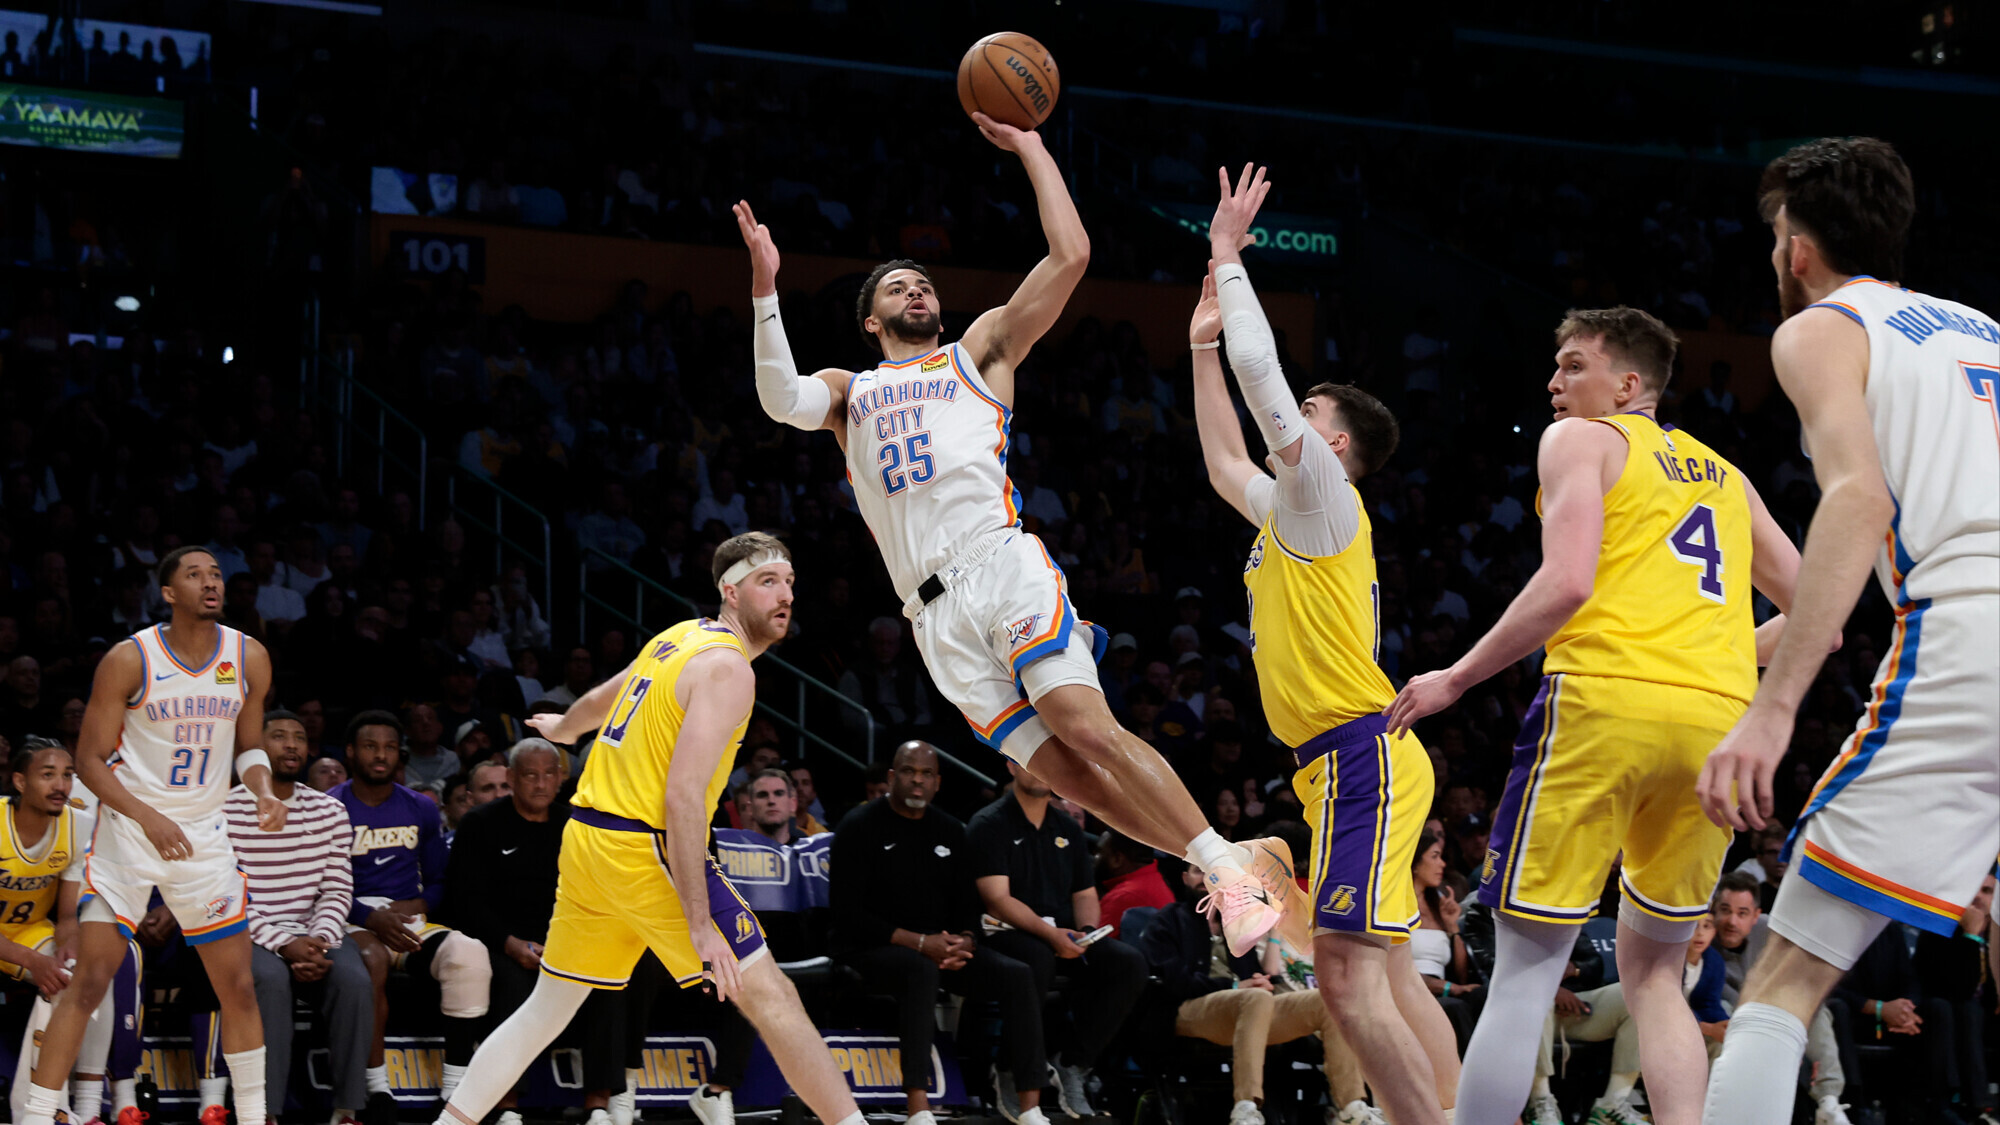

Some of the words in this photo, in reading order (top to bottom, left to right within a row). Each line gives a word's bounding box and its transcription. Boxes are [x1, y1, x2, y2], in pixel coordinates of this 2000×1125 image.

[1006, 56, 1050, 115] Wilson
[402, 237, 470, 274] 101
[1250, 226, 1338, 255] o.com
[848, 378, 959, 427] OKLAHOMA
[875, 405, 924, 441] CITY
[877, 430, 936, 498] 25
[1665, 502, 1726, 605] 4
[174, 721, 216, 744] CITY
[167, 746, 213, 790] 21
[351, 825, 419, 856] LAKERS
[383, 1048, 446, 1089] RIM
[637, 1048, 700, 1088] IME
[830, 1047, 903, 1087] PRIM
